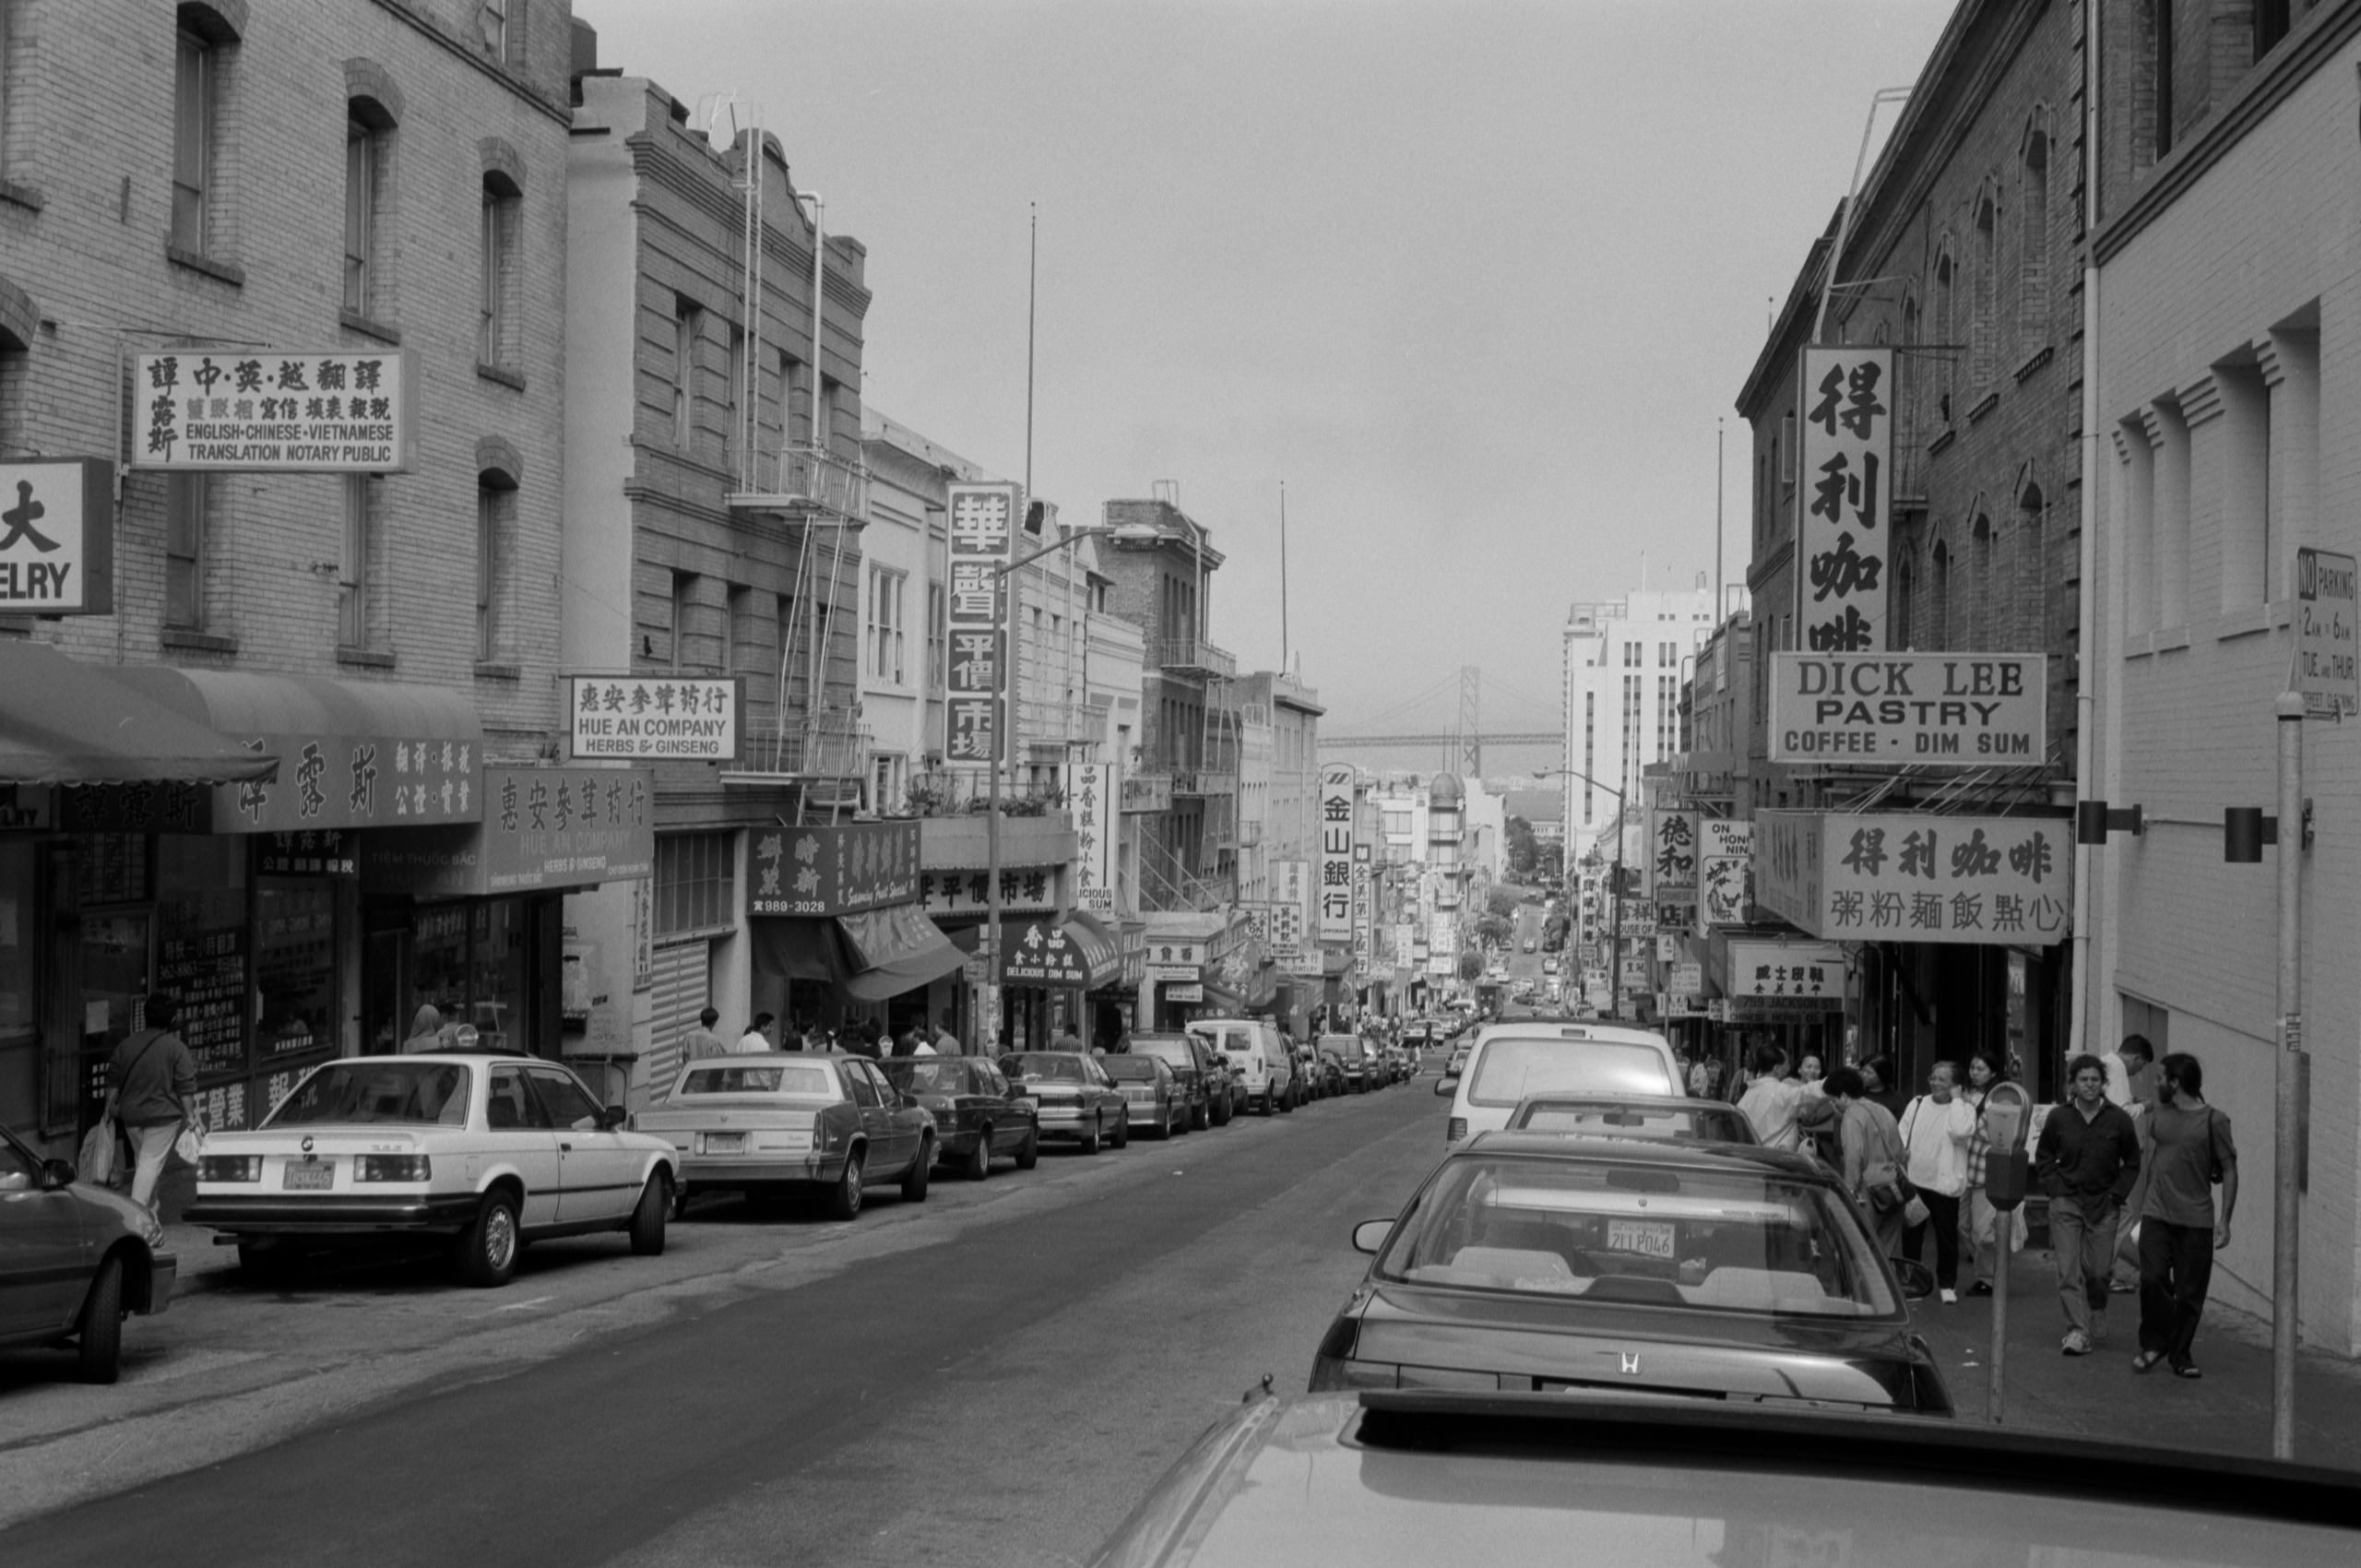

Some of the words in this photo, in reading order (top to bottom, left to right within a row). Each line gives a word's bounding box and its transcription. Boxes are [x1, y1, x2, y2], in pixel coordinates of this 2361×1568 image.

[188, 444, 279, 461] TRANSLATION
[287, 445, 339, 462] NOTARY
[343, 445, 390, 462] PUBLIC
[1809, 361, 1887, 651] 得利咖啡
[0, 480, 61, 553] 大
[2300, 552, 2316, 595] NO
[2319, 567, 2354, 600] PARKING
[2302, 651, 2319, 678] TUE
[2332, 655, 2355, 680] THUR
[1798, 661, 1913, 696] DICK
[1943, 662, 2023, 696] LEE
[1816, 700, 2002, 726] PASTRY
[579, 719, 612, 735] HUE
[617, 719, 640, 736] AN
[644, 719, 726, 737] COMPANY
[586, 740, 635, 753] HERBS
[656, 740, 719, 754] GINSENG
[1785, 731, 1876, 753] COFFEE
[1916, 733, 1959, 754] DIM
[1977, 733, 2030, 754] SUM
[1712, 824, 1730, 834] ON
[520, 834, 547, 855] HUE
[553, 832, 570, 853] AN
[575, 830, 630, 852] COMPANY
[1726, 846, 1748, 855] NIN
[544, 858, 568, 873] HERBS
[576, 856, 606, 871] GINSENG
[1323, 795, 1351, 919] 金山銀行
[1841, 827, 2053, 885] 得利咖啡
[1079, 888, 1112, 899] ICIOUS
[765, 900, 825, 912] 989-3028
[1088, 899, 1112, 909] SUM
[1620, 925, 1640, 934] OUSE
[1642, 925, 1652, 934] OF
[1006, 967, 1045, 978] DELICIOUS
[1049, 968, 1062, 979] DIM
[1066, 969, 1083, 980] SUM
[1768, 997, 1818, 1009] JACKSON
